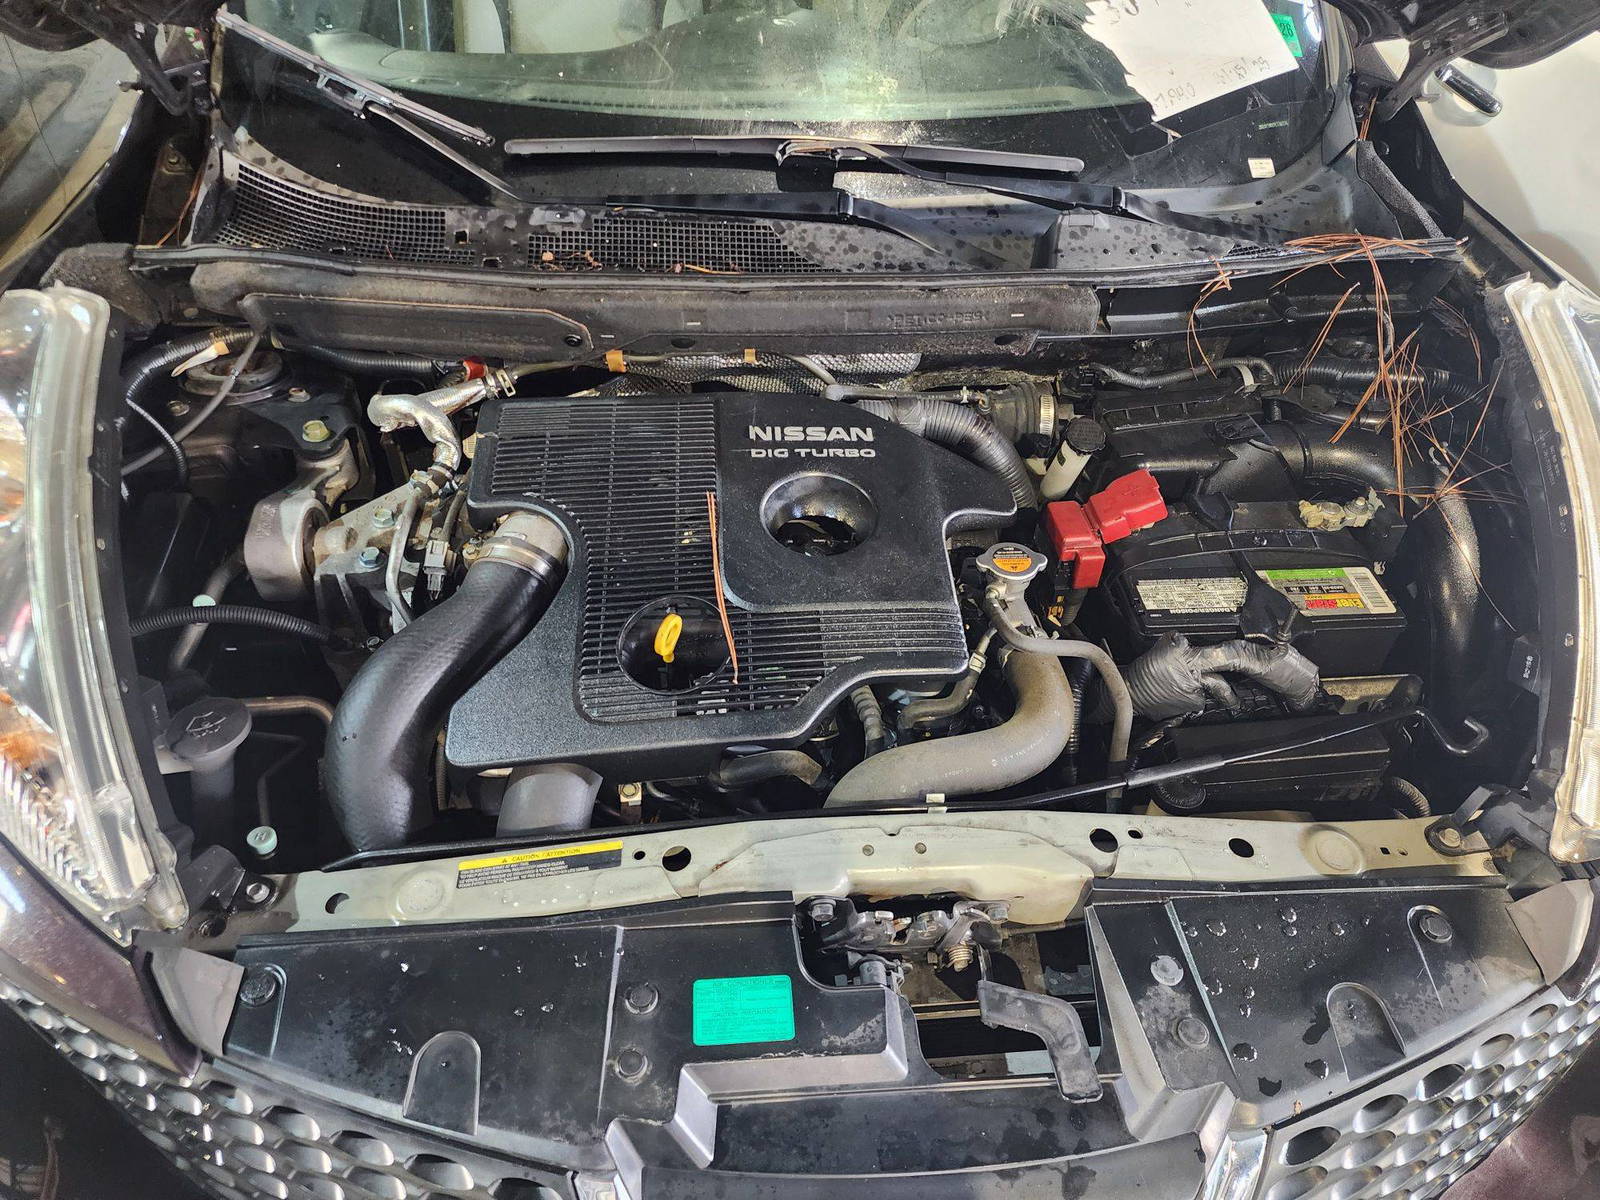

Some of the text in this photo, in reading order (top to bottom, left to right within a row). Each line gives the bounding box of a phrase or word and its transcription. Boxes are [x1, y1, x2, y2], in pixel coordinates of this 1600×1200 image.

[748, 425, 875, 442] NISSAN
[751, 448, 877, 460] DIG TURBO
